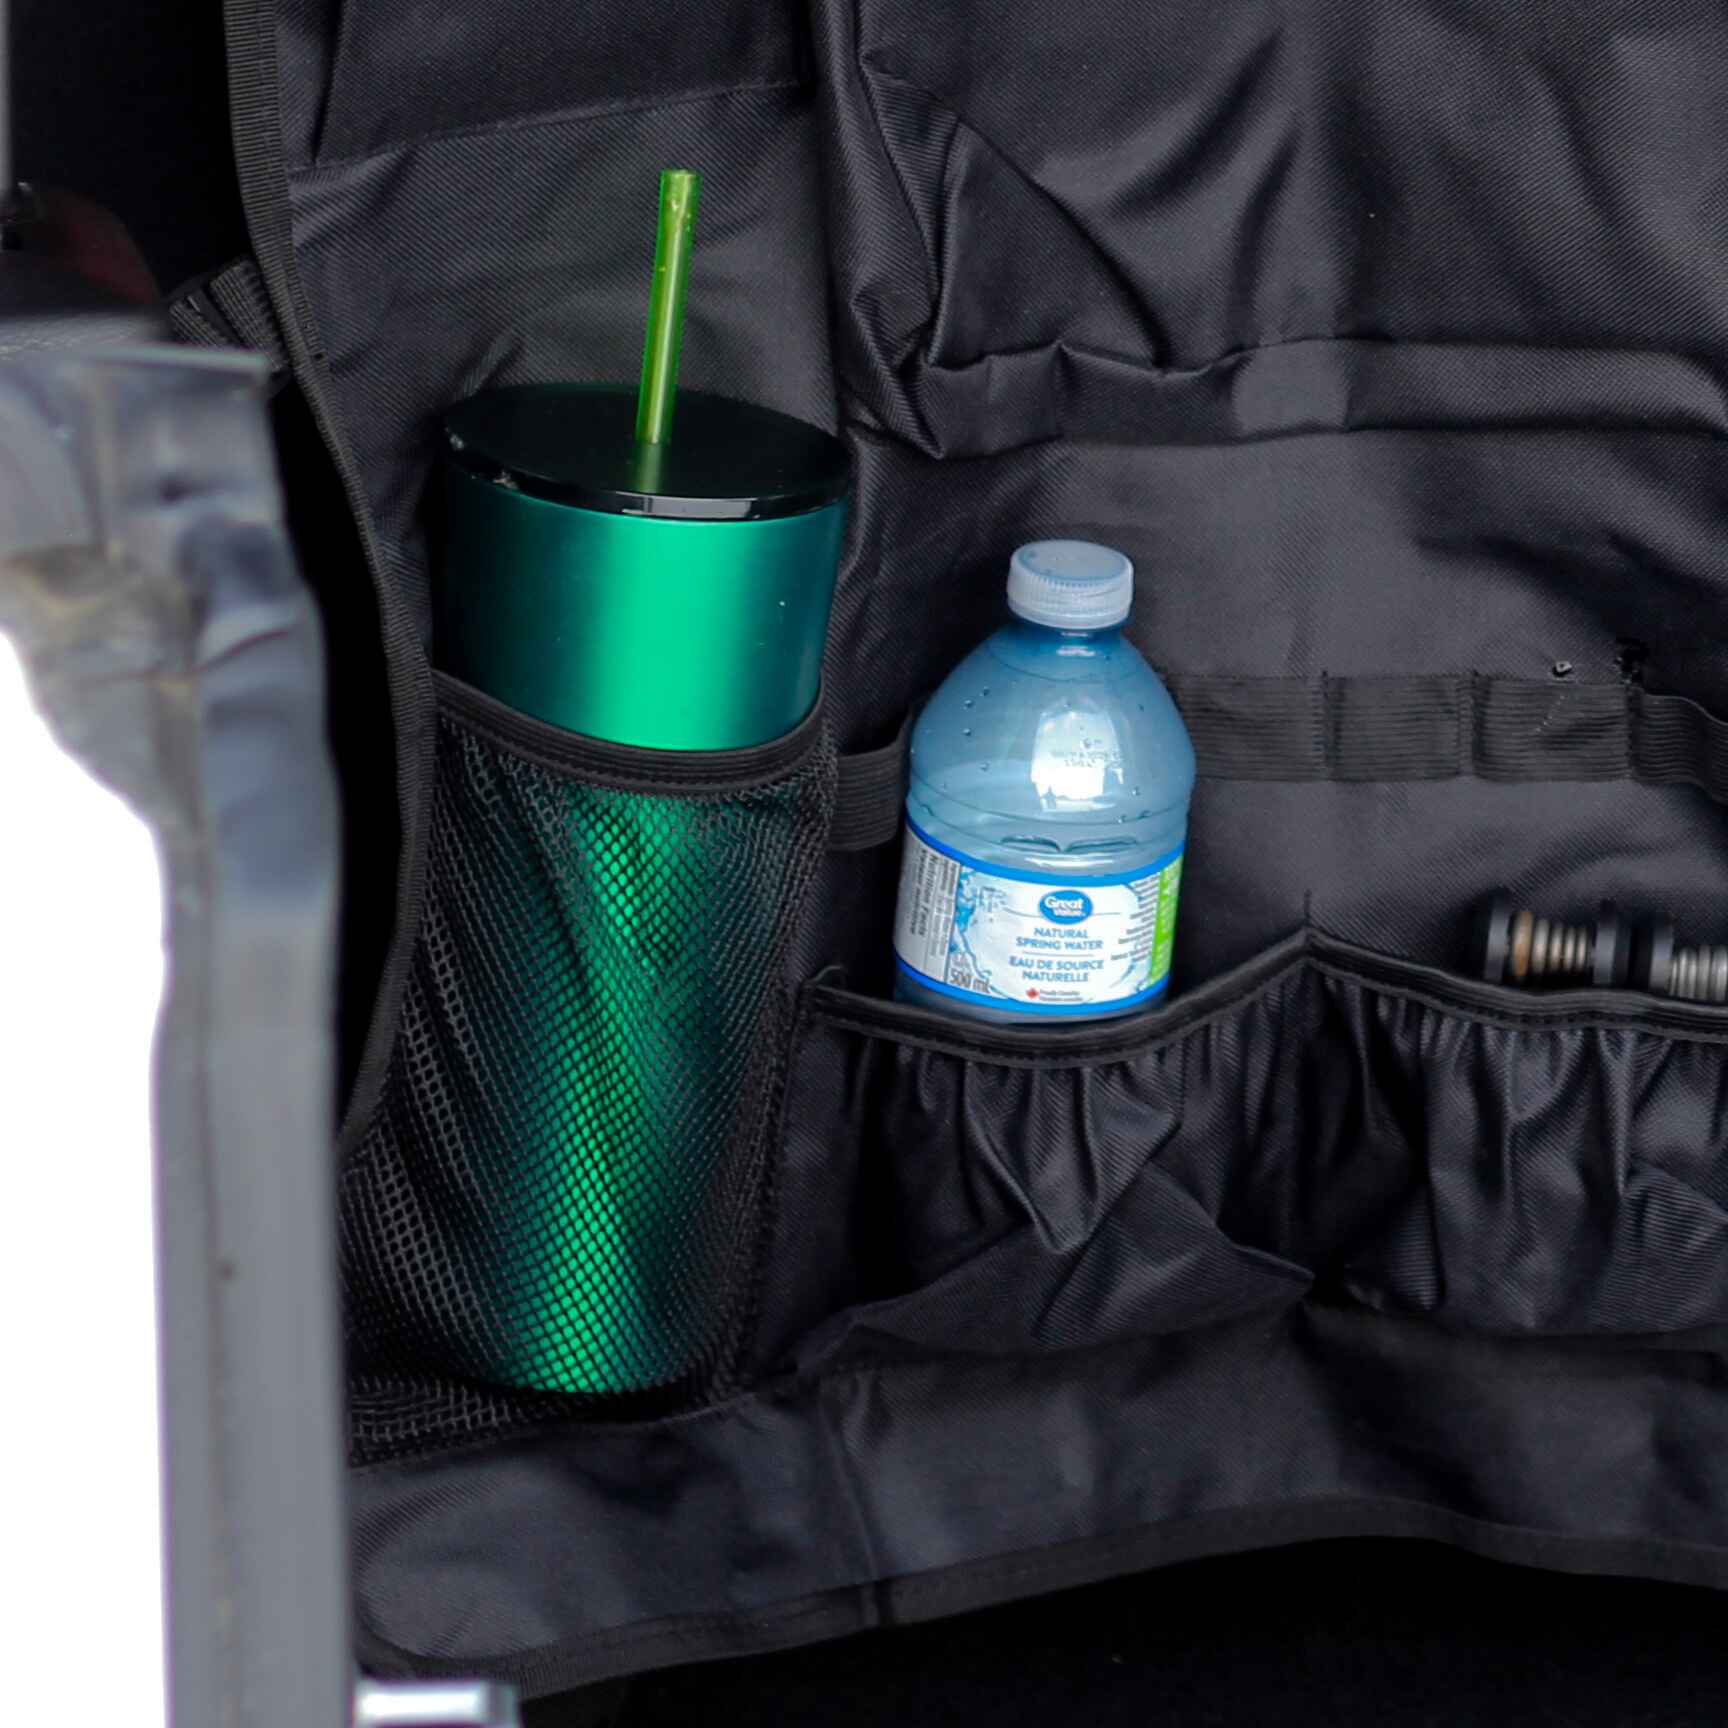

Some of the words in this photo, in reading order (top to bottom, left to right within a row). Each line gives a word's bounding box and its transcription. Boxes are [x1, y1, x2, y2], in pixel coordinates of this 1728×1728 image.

[1044, 895, 1084, 911] Great
[1033, 927, 1089, 939] NATURAL
[1015, 936, 1062, 951] SPRING
[1063, 939, 1104, 950] WATER
[1008, 955, 1035, 969] EAU
[1036, 958, 1054, 970] DE
[1055, 959, 1105, 971] SOURCE
[1022, 970, 1089, 983] NATURELLE
